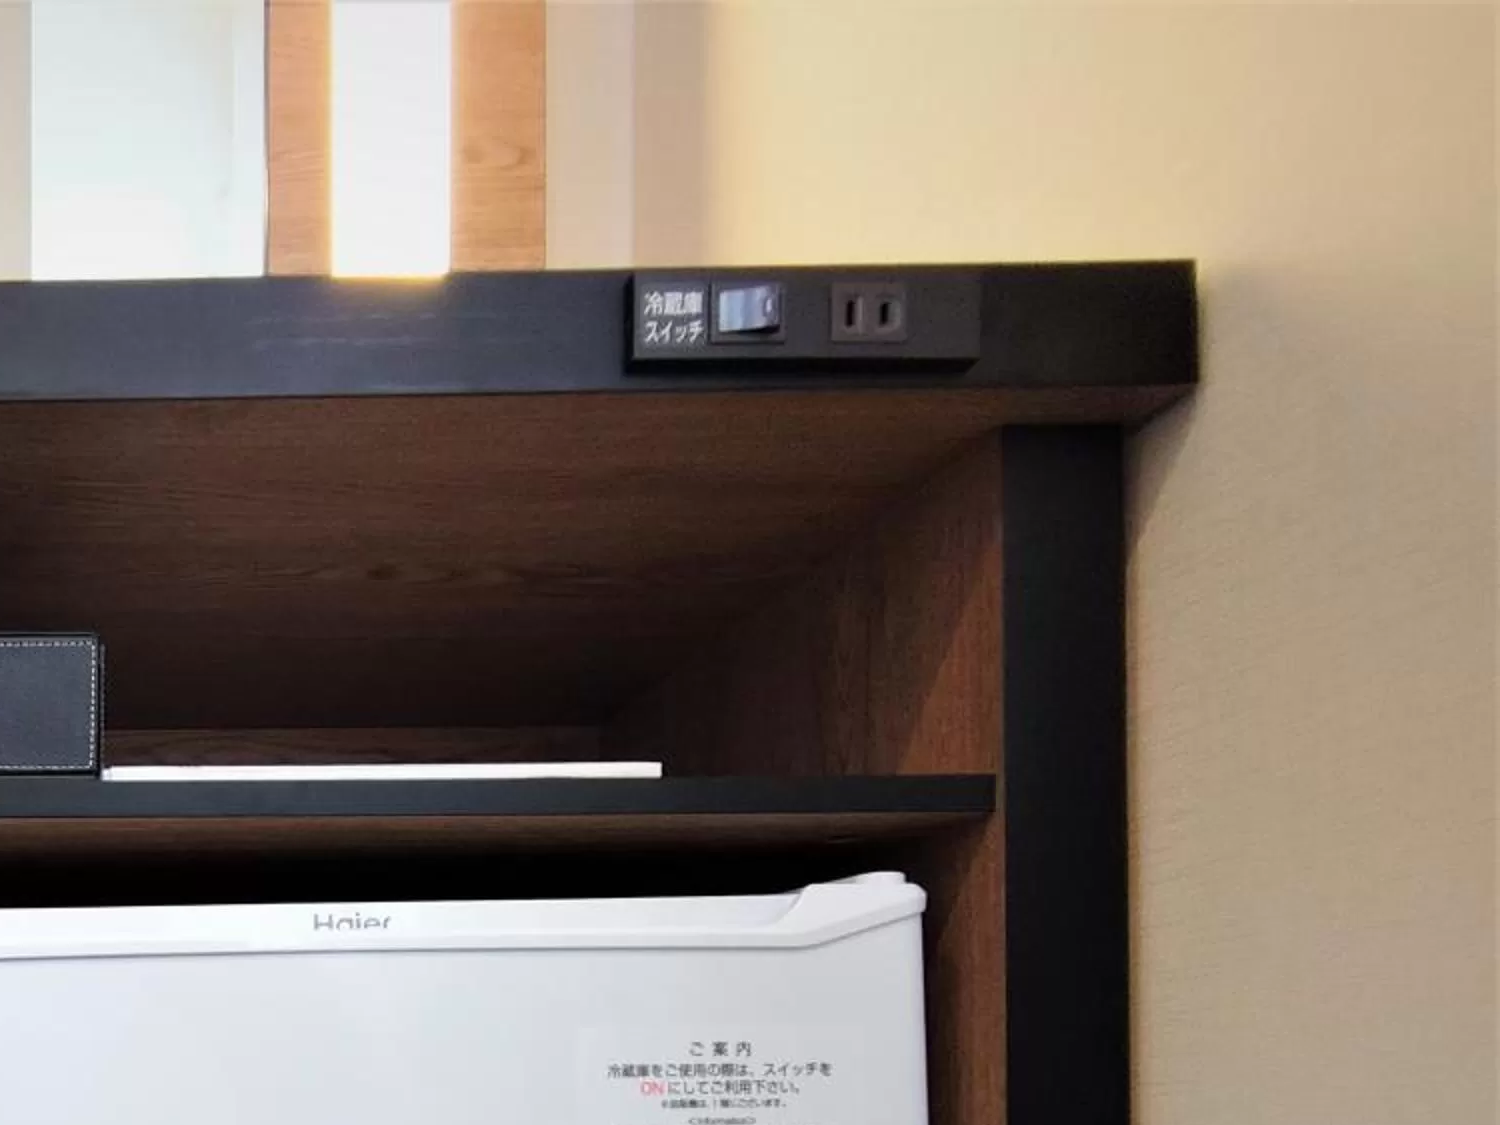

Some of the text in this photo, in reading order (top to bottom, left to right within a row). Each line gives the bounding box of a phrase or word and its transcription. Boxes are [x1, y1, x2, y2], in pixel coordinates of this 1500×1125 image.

[643, 290, 704, 316] 冷蔵庫
[644, 320, 705, 345] スイッチ
[313, 911, 391, 931] Haier
